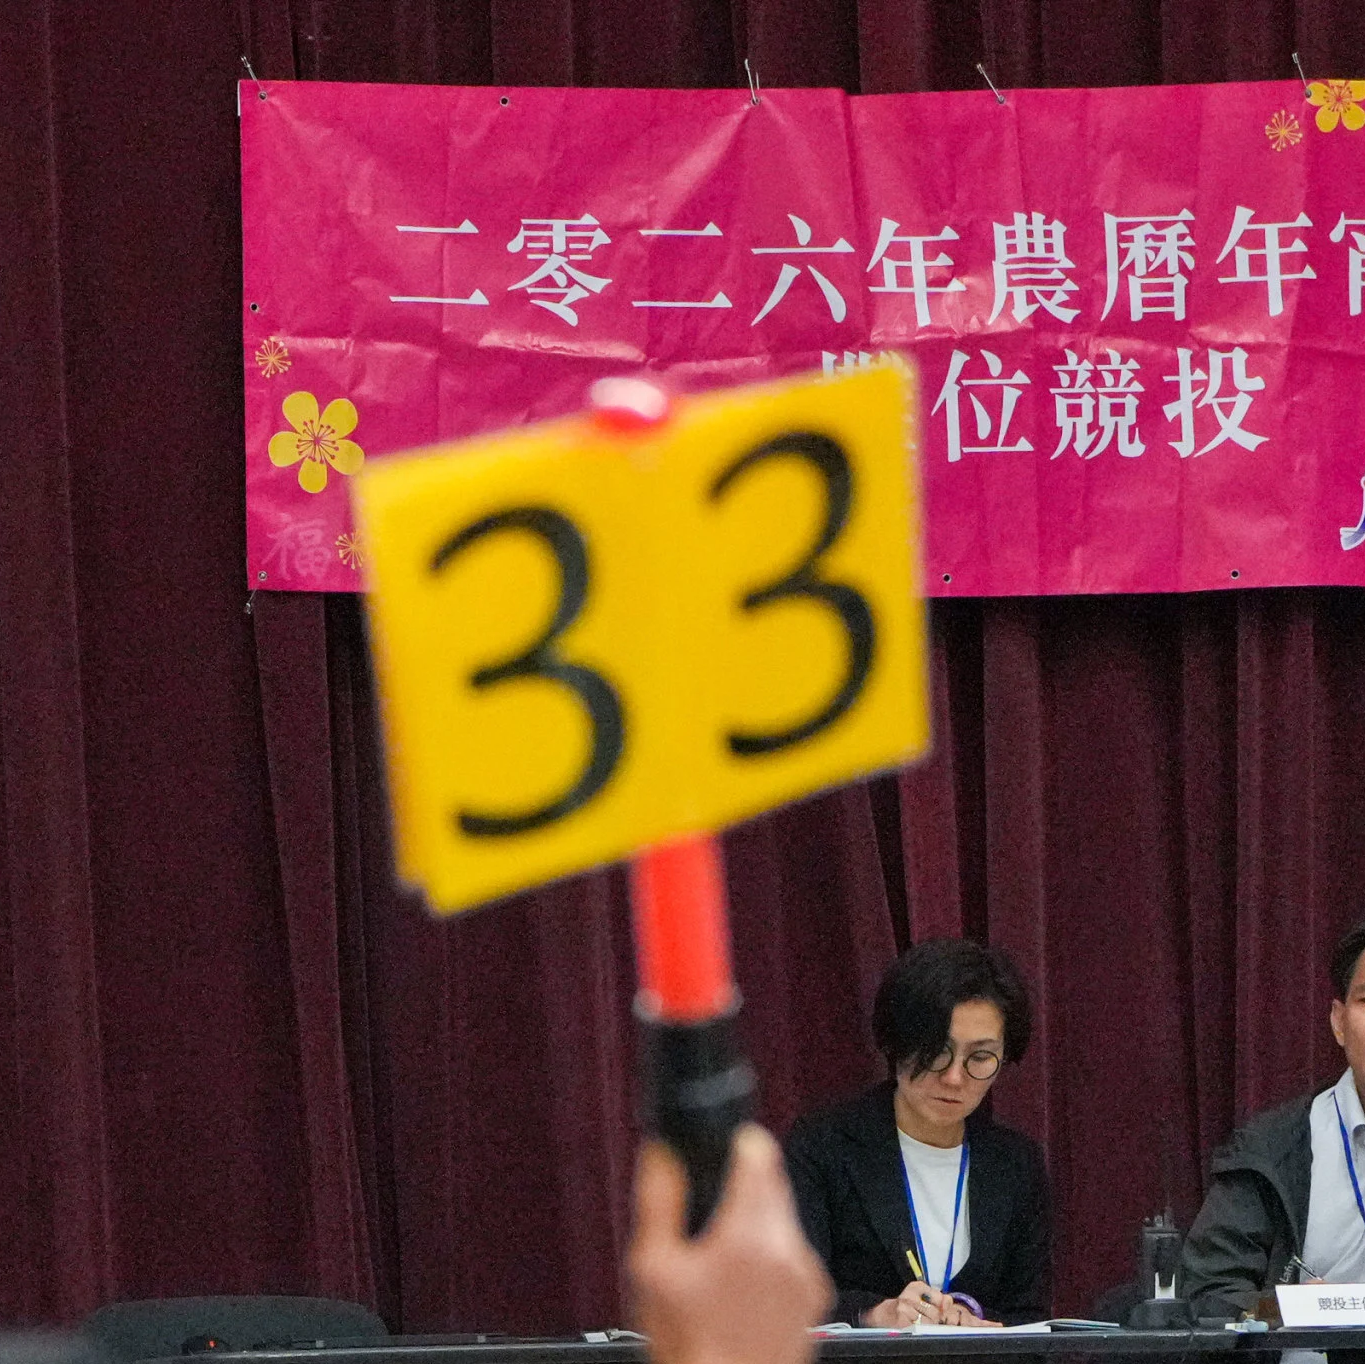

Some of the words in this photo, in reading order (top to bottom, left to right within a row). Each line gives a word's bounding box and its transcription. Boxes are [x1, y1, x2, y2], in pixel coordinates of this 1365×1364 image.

[822, 346, 1270, 462] 位競投
[430, 430, 876, 838] 33
